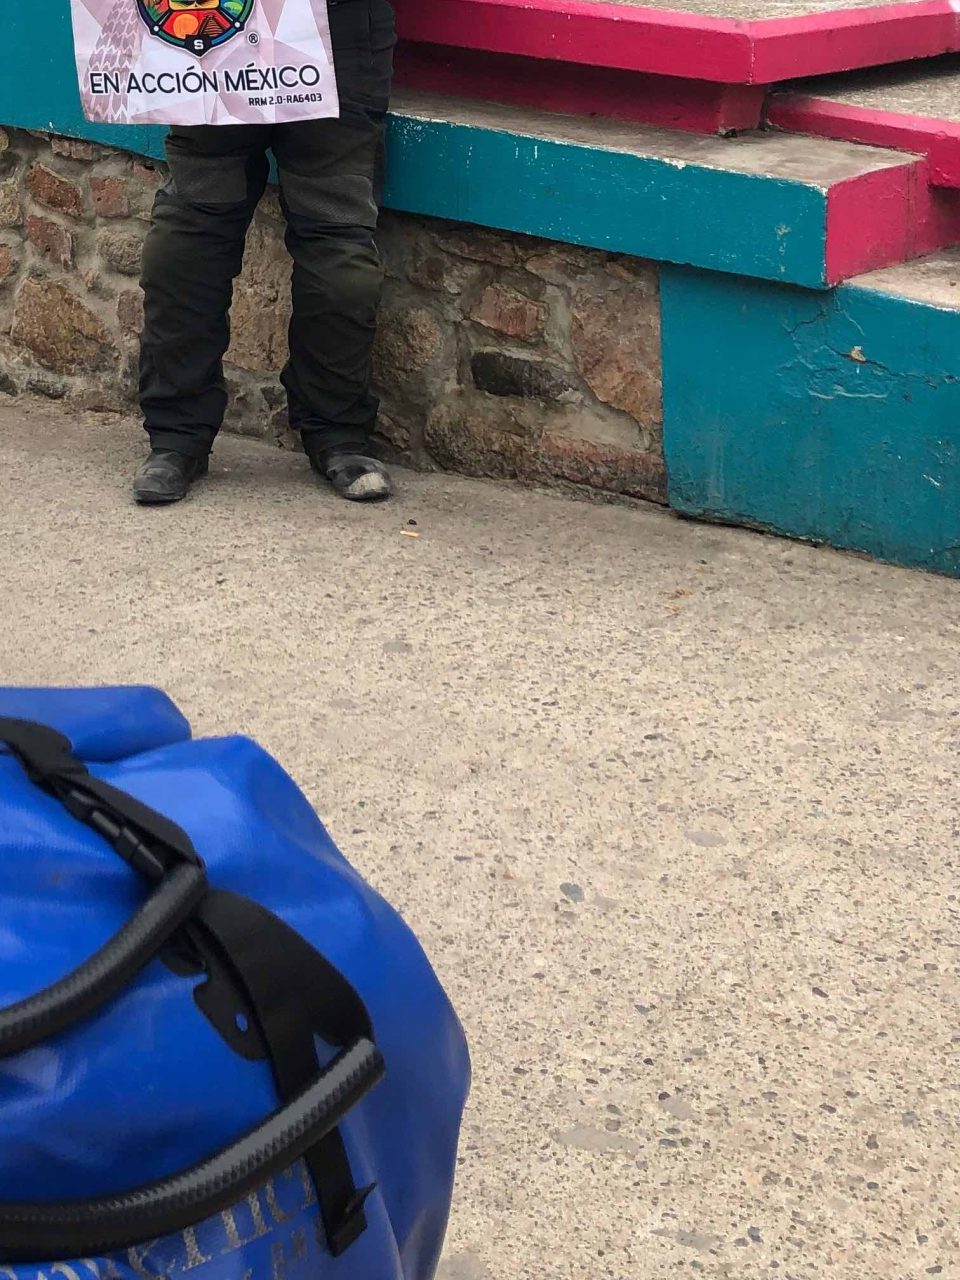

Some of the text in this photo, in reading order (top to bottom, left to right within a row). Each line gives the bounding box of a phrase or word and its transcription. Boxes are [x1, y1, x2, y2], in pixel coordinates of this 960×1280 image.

[193, 39, 204, 50] S
[90, 63, 321, 95] EN ACCIÓN MÉXICO
[248, 93, 323, 107] RRM 2.0-RA6403
